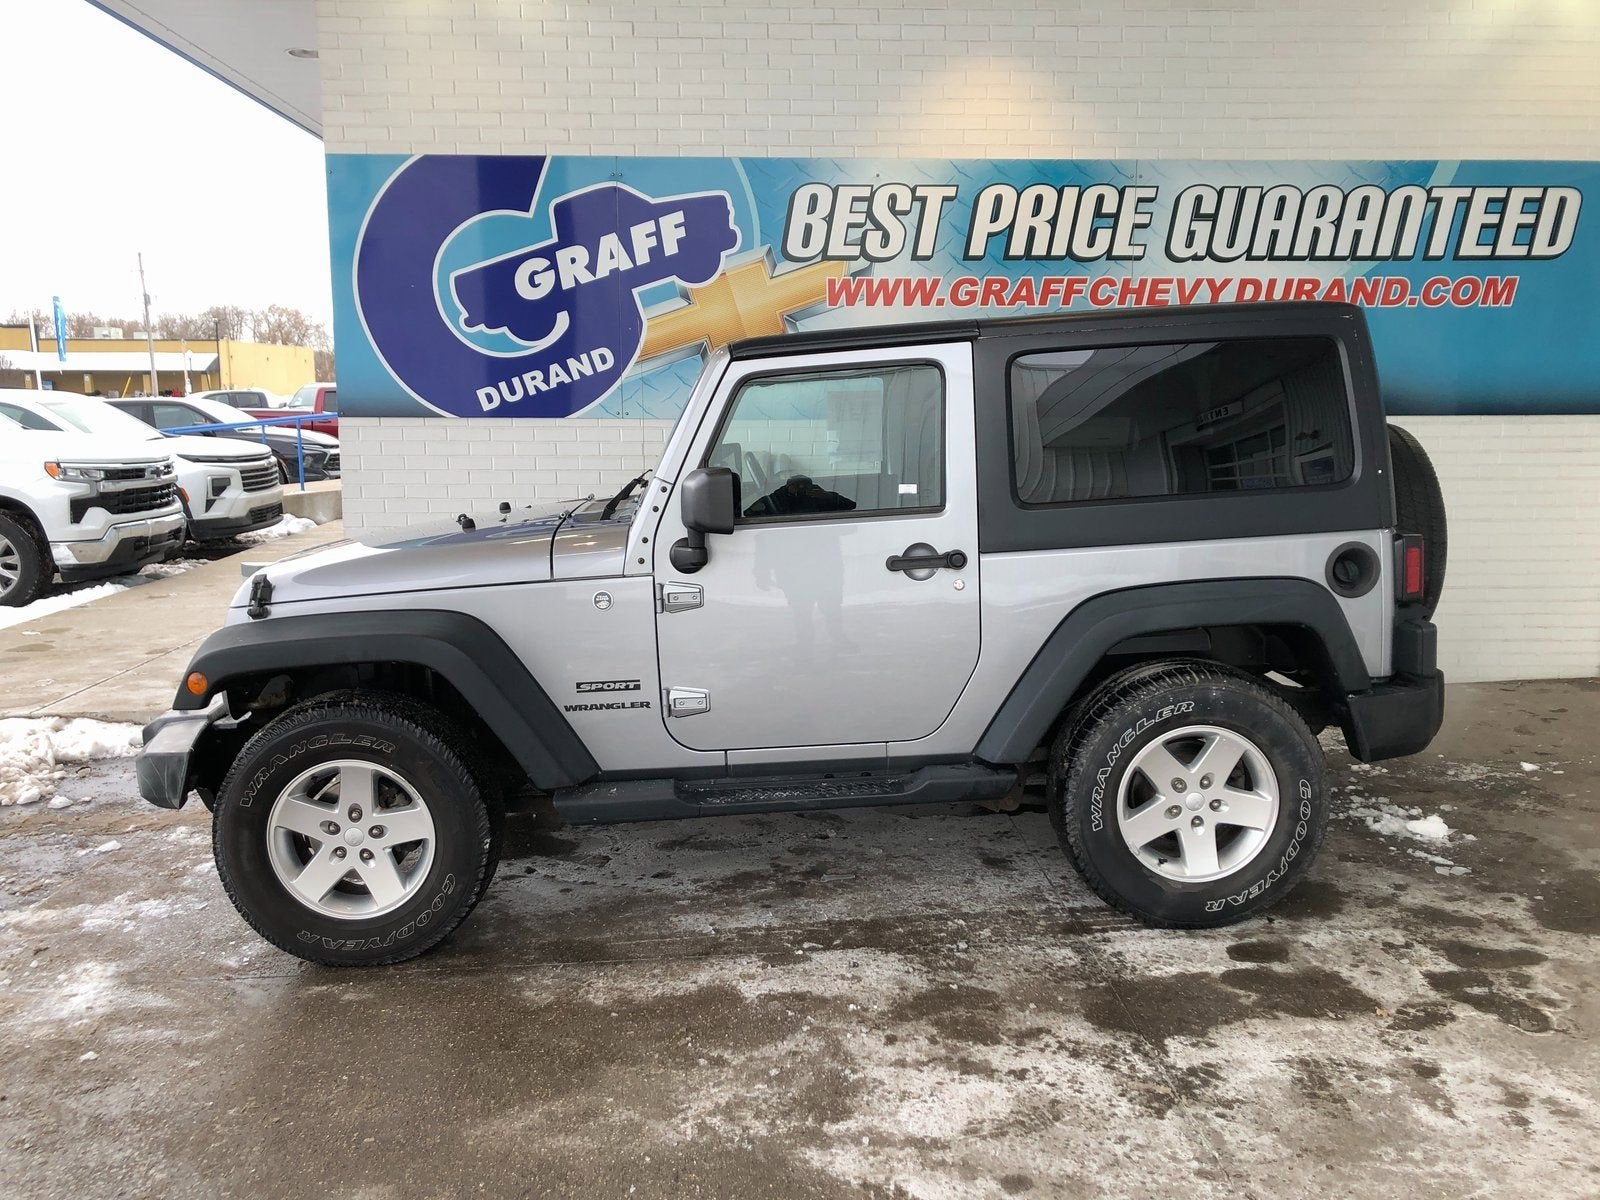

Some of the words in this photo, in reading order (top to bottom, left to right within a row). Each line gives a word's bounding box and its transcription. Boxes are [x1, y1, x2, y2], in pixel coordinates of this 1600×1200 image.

[514, 210, 687, 300] GRAFF
[781, 183, 959, 262] BEST
[963, 183, 1159, 262] PRICE
[1165, 183, 1583, 263] GUARANTEED
[825, 275, 1520, 308] WWW.GRAFFCHEVYDURAND.COM
[475, 347, 615, 412] DURAND
[563, 701, 651, 712] WRANGLER
[577, 680, 641, 692] SPORT
[239, 733, 396, 808] WRANGLER
[1091, 701, 1195, 832] WRANGLER
[1204, 779, 1312, 912] GOODYEAR
[297, 873, 456, 951] GOODYEAR
